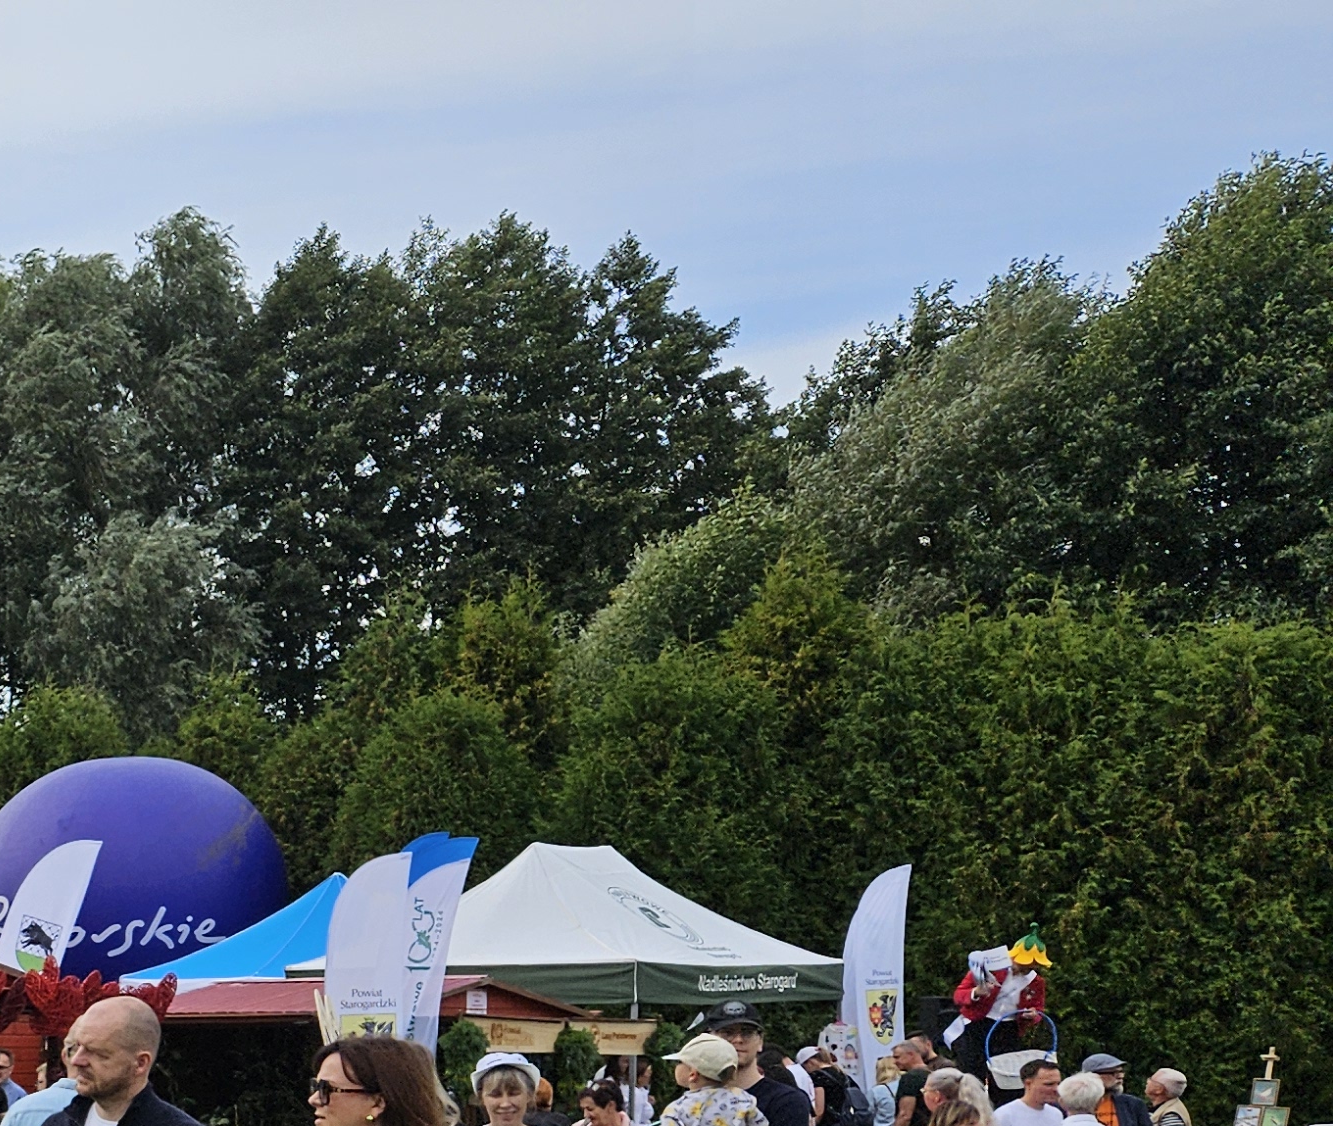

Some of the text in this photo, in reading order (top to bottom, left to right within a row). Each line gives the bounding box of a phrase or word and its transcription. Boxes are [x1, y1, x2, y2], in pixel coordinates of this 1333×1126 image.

[698, 972, 799, 993] Nadleśnictwo Starogard
[351, 988, 383, 998] Powiat
[340, 998, 397, 1011] Starogardzki
